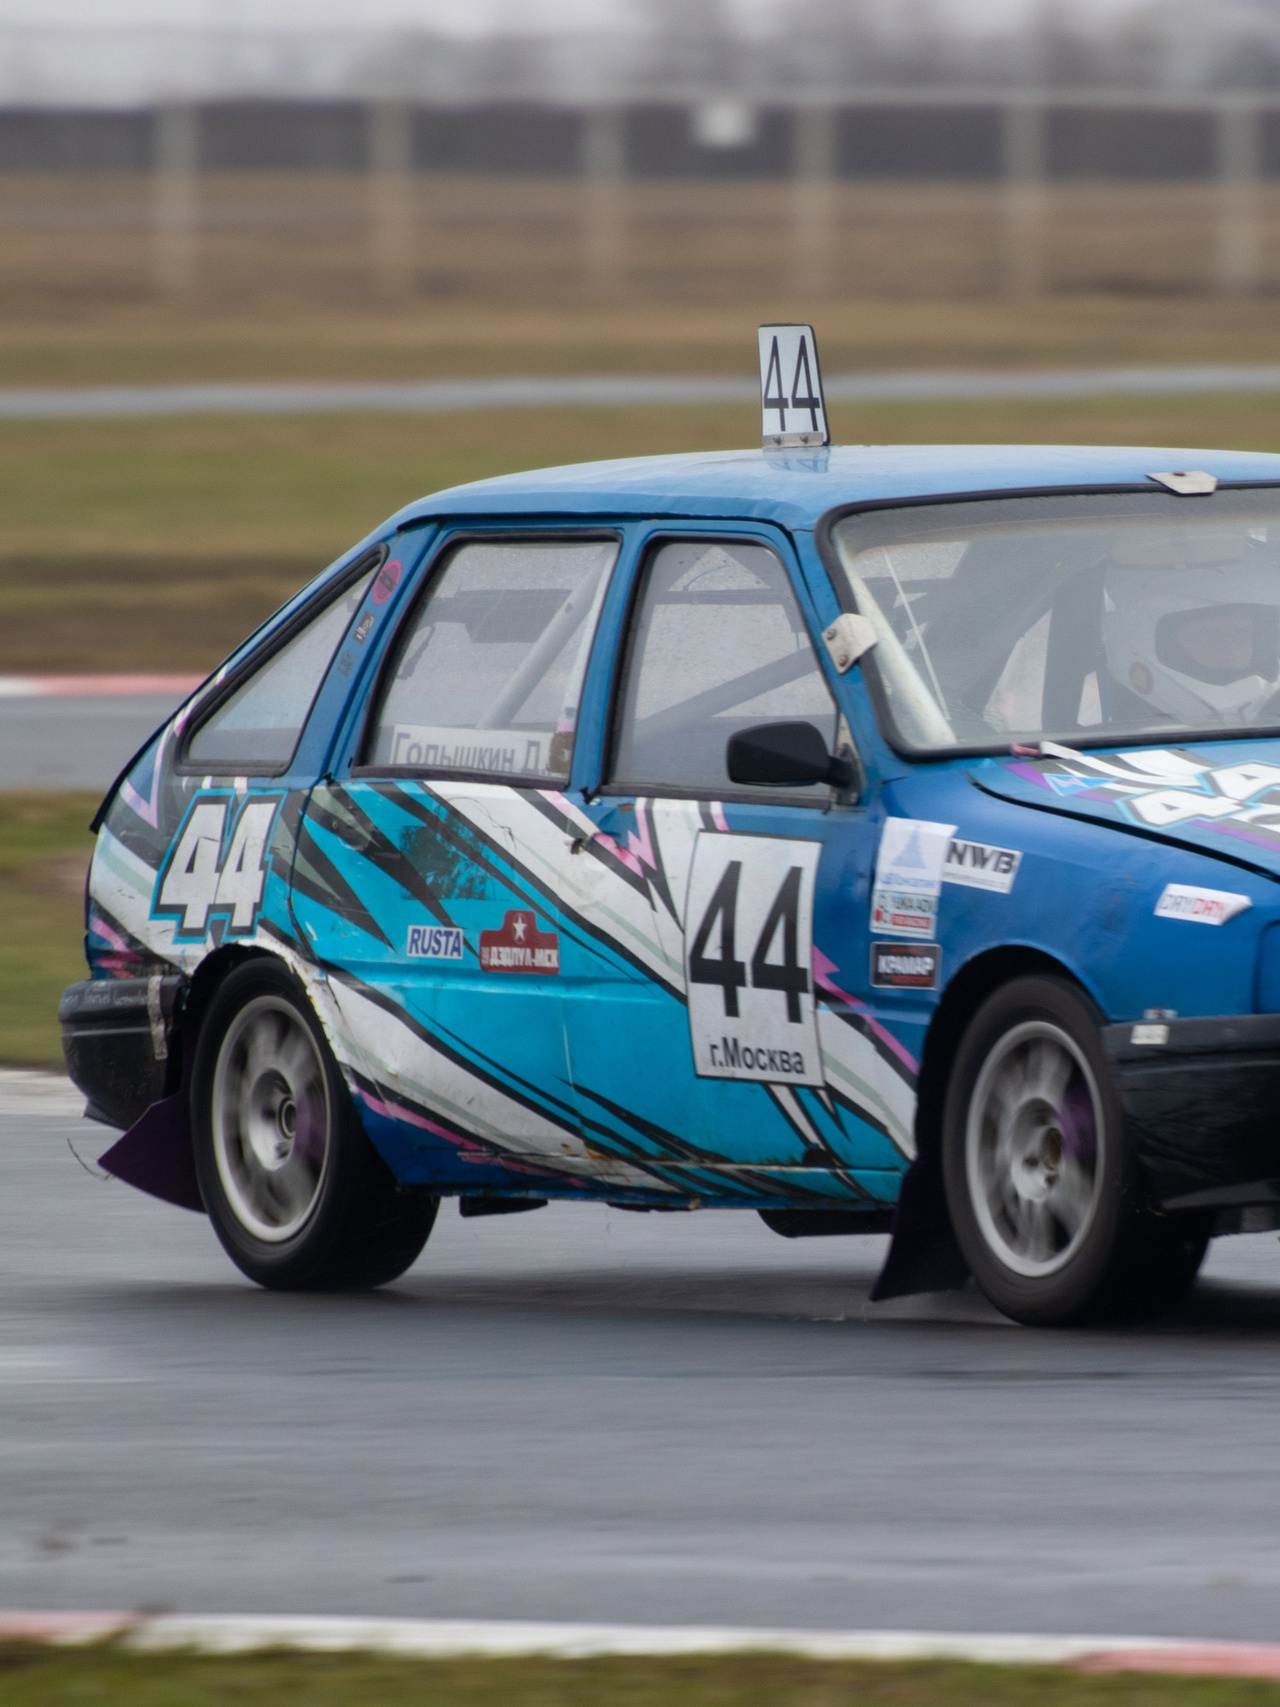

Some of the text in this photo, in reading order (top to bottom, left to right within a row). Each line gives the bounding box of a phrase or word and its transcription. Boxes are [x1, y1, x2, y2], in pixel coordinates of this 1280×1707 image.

[763, 335, 821, 432] 44
[154, 796, 281, 935] 44
[945, 841, 1015, 874] NWB
[409, 928, 462, 957] RUSTA
[690, 860, 809, 1024] 44
[709, 1036, 806, 1075] г.Москва
